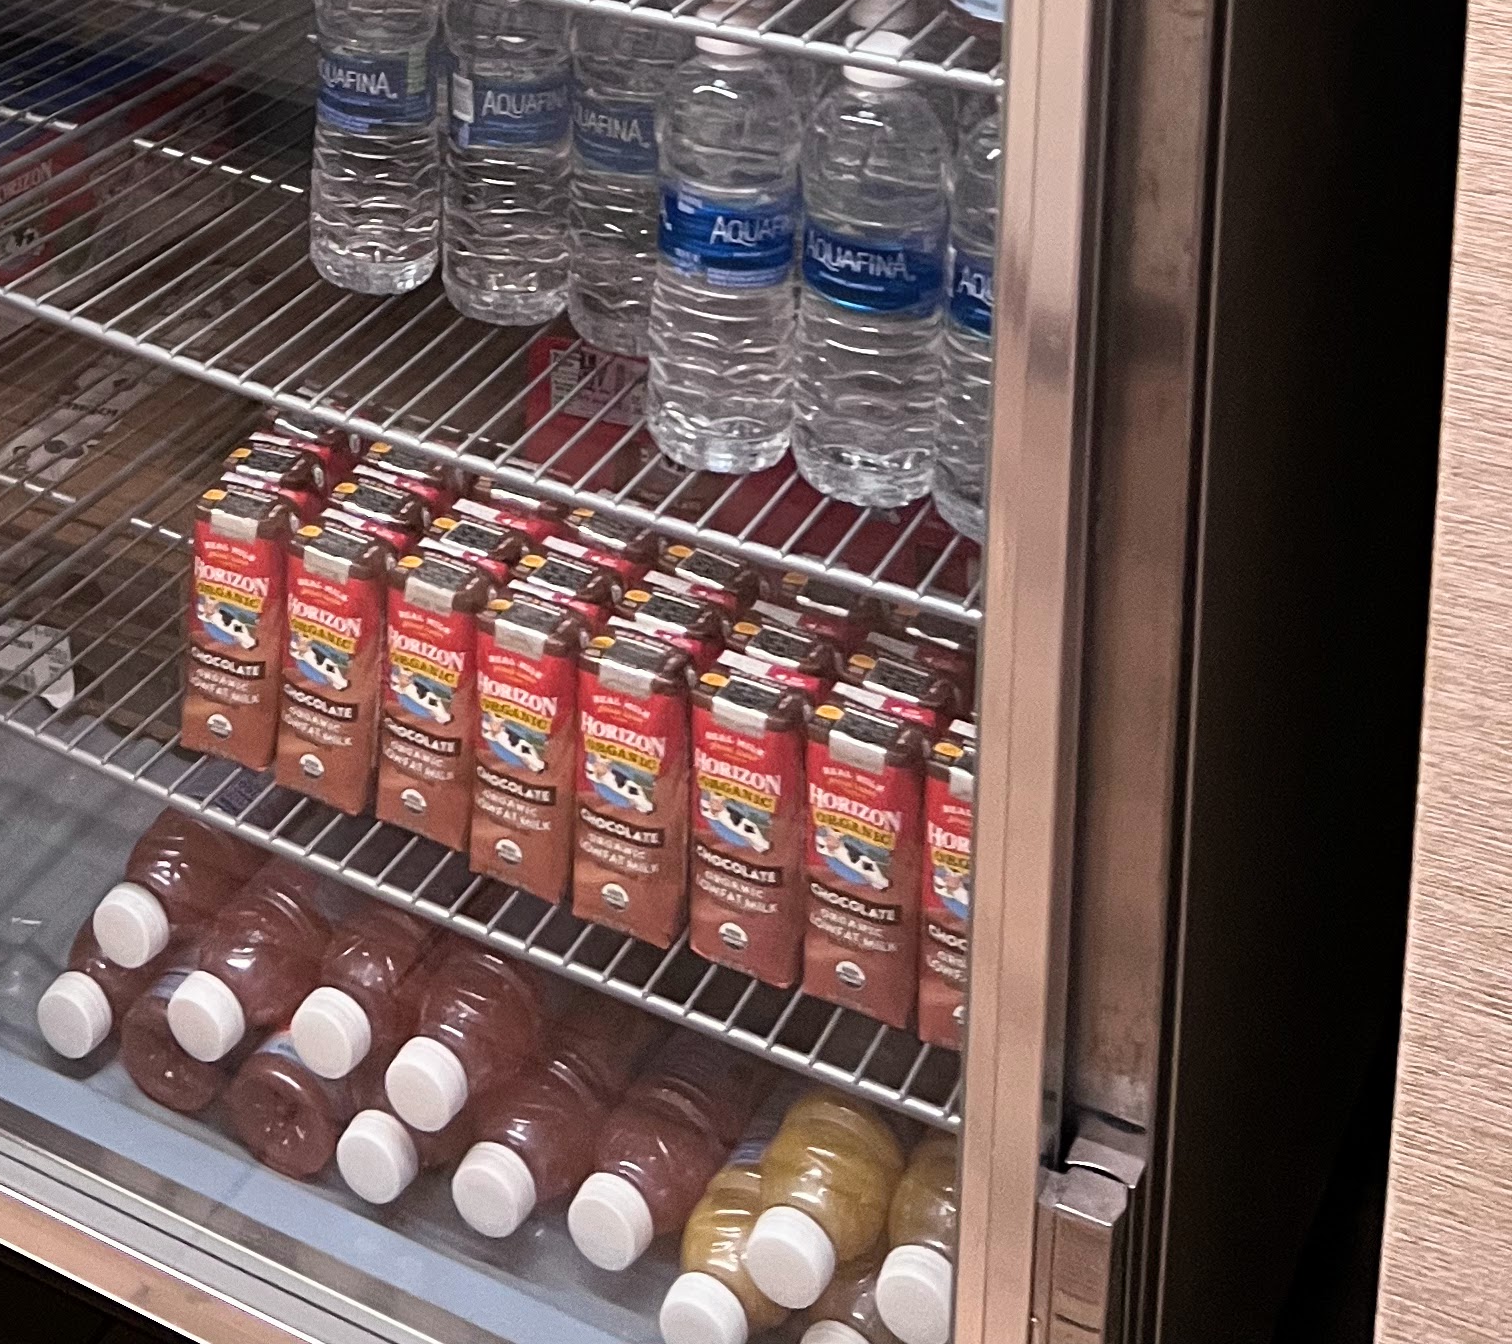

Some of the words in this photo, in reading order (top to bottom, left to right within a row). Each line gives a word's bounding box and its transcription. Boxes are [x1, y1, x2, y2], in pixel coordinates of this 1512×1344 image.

[288, 593, 362, 637] HORIZON
[388, 624, 466, 672] HORIZON
[477, 670, 558, 717] HORIZON
[581, 711, 666, 759] HORIZON
[694, 748, 781, 796] HORIZON
[580, 808, 659, 844] CHOCOLATE
[809, 782, 901, 832] HORIZON
[810, 882, 895, 921] CHOCOLATE
